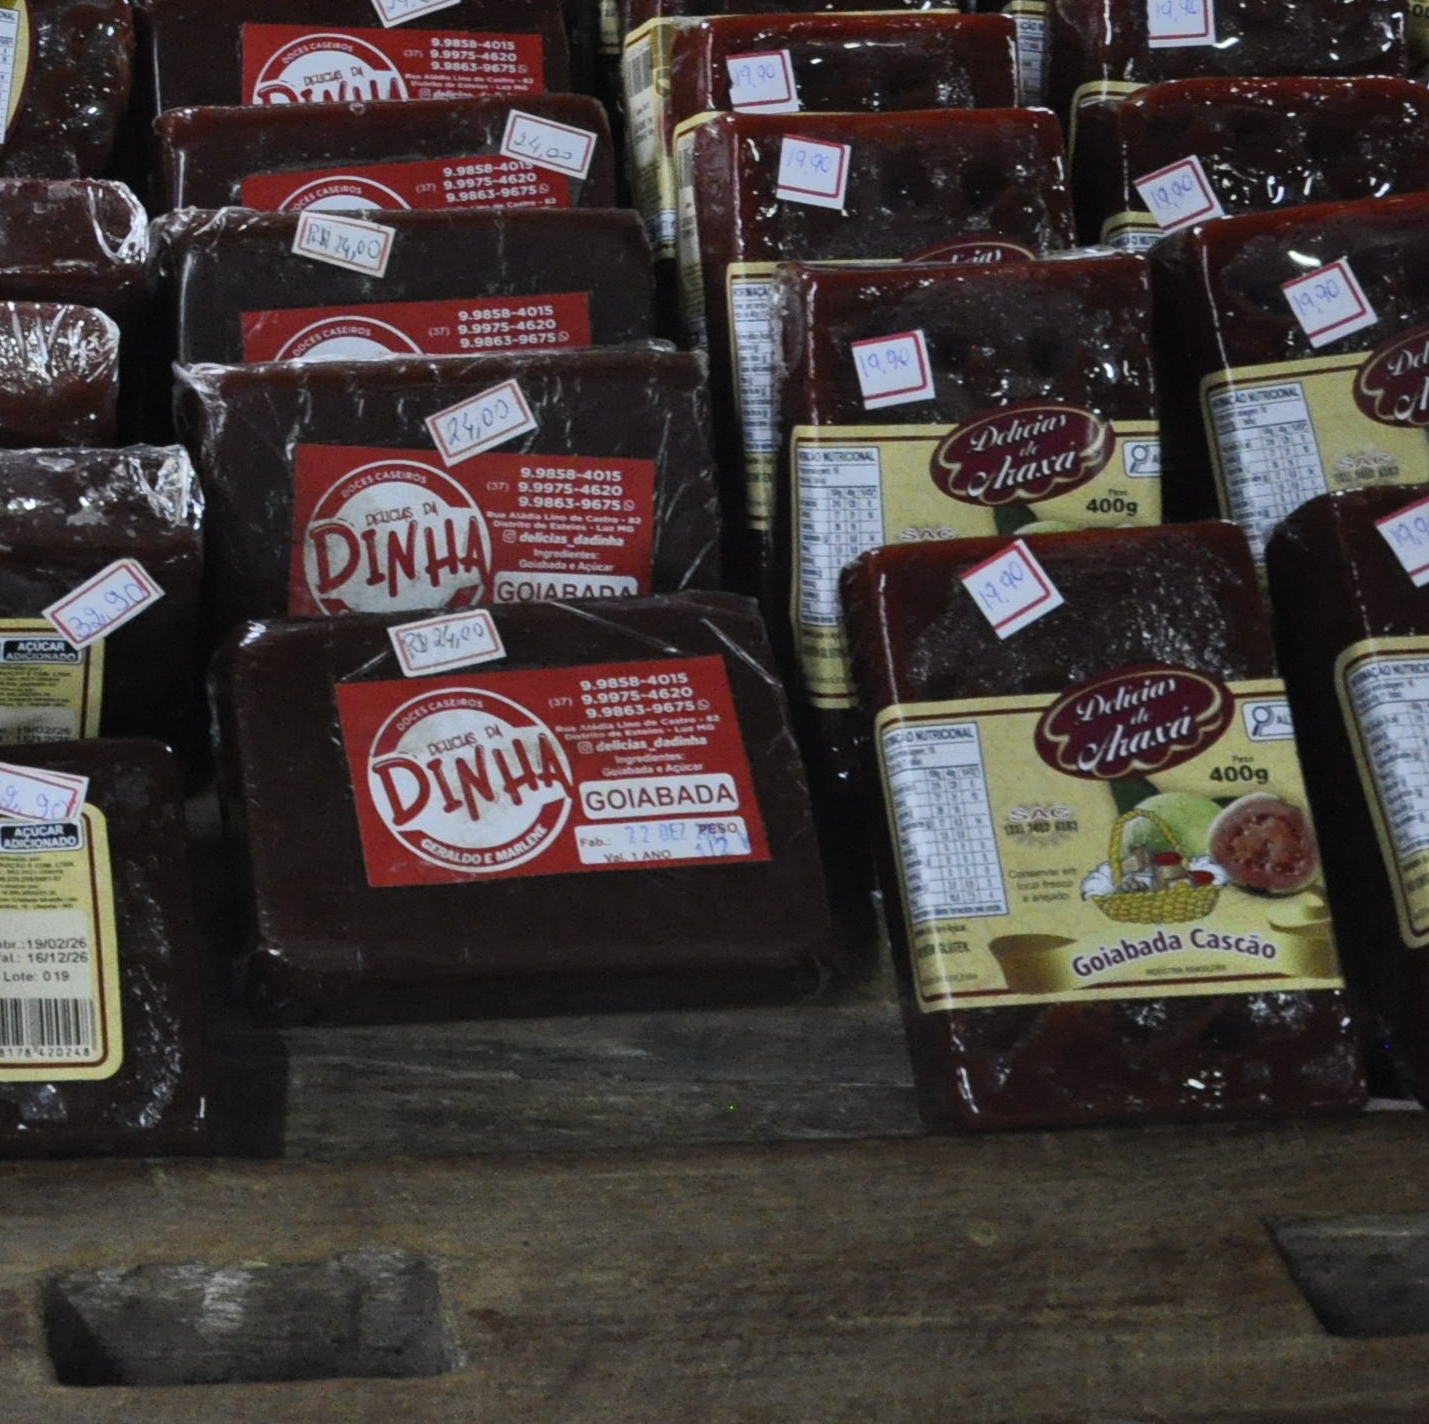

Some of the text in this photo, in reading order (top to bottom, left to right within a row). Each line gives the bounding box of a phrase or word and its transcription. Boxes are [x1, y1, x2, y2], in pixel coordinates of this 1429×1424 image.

[430, 37, 515, 51] 9.9858-4015
[403, 49, 518, 63] (37) 9.9975-4620
[430, 61, 517, 74] 9.9863-9675
[446, 184, 539, 203] 9.9863-9675
[458, 305, 555, 323] 9.9858-4015
[428, 318, 557, 337] (37) 9.9975-4620
[459, 331, 557, 349] 9.9863-9675
[968, 412, 1067, 456] Delícias
[520, 467, 622, 481] 9.9858-4015
[963, 445, 1078, 499] Araxá
[486, 481, 623, 496] (37) 9.9975-4620
[518, 496, 622, 510] 9.9863-9675
[1085, 495, 1138, 518] 400g
[520, 532, 624, 548] delicias_dadinha
[308, 516, 491, 598] DINHA
[16, 640, 66, 654] AÇÚCAR
[580, 673, 688, 691] 9.9858-4015
[549, 687, 693, 708] (37) 9.9975-4620
[1074, 675, 1178, 724] Delícias
[397, 698, 483, 731] DOCES CASEIROS
[585, 701, 695, 718] 9.9863-9675
[914, 725, 975, 743] NUTRICIONAL
[1076, 704, 1196, 772] Araxá
[596, 735, 708, 752] delicias_dadinha
[371, 732, 573, 826] DINHA
[1209, 764, 1269, 786] 400g
[586, 783, 736, 811] GOIABADA
[1009, 804, 1072, 822] SAC
[13, 825, 64, 838] AÇÚCAR
[4, 835, 77, 848] ADICIONADO
[26, 937, 87, 949] 19/02/26
[28, 952, 88, 963] 16/12/26
[1071, 927, 1278, 980] Goiabada Cascão
[4, 971, 70, 982] Lote: 019
